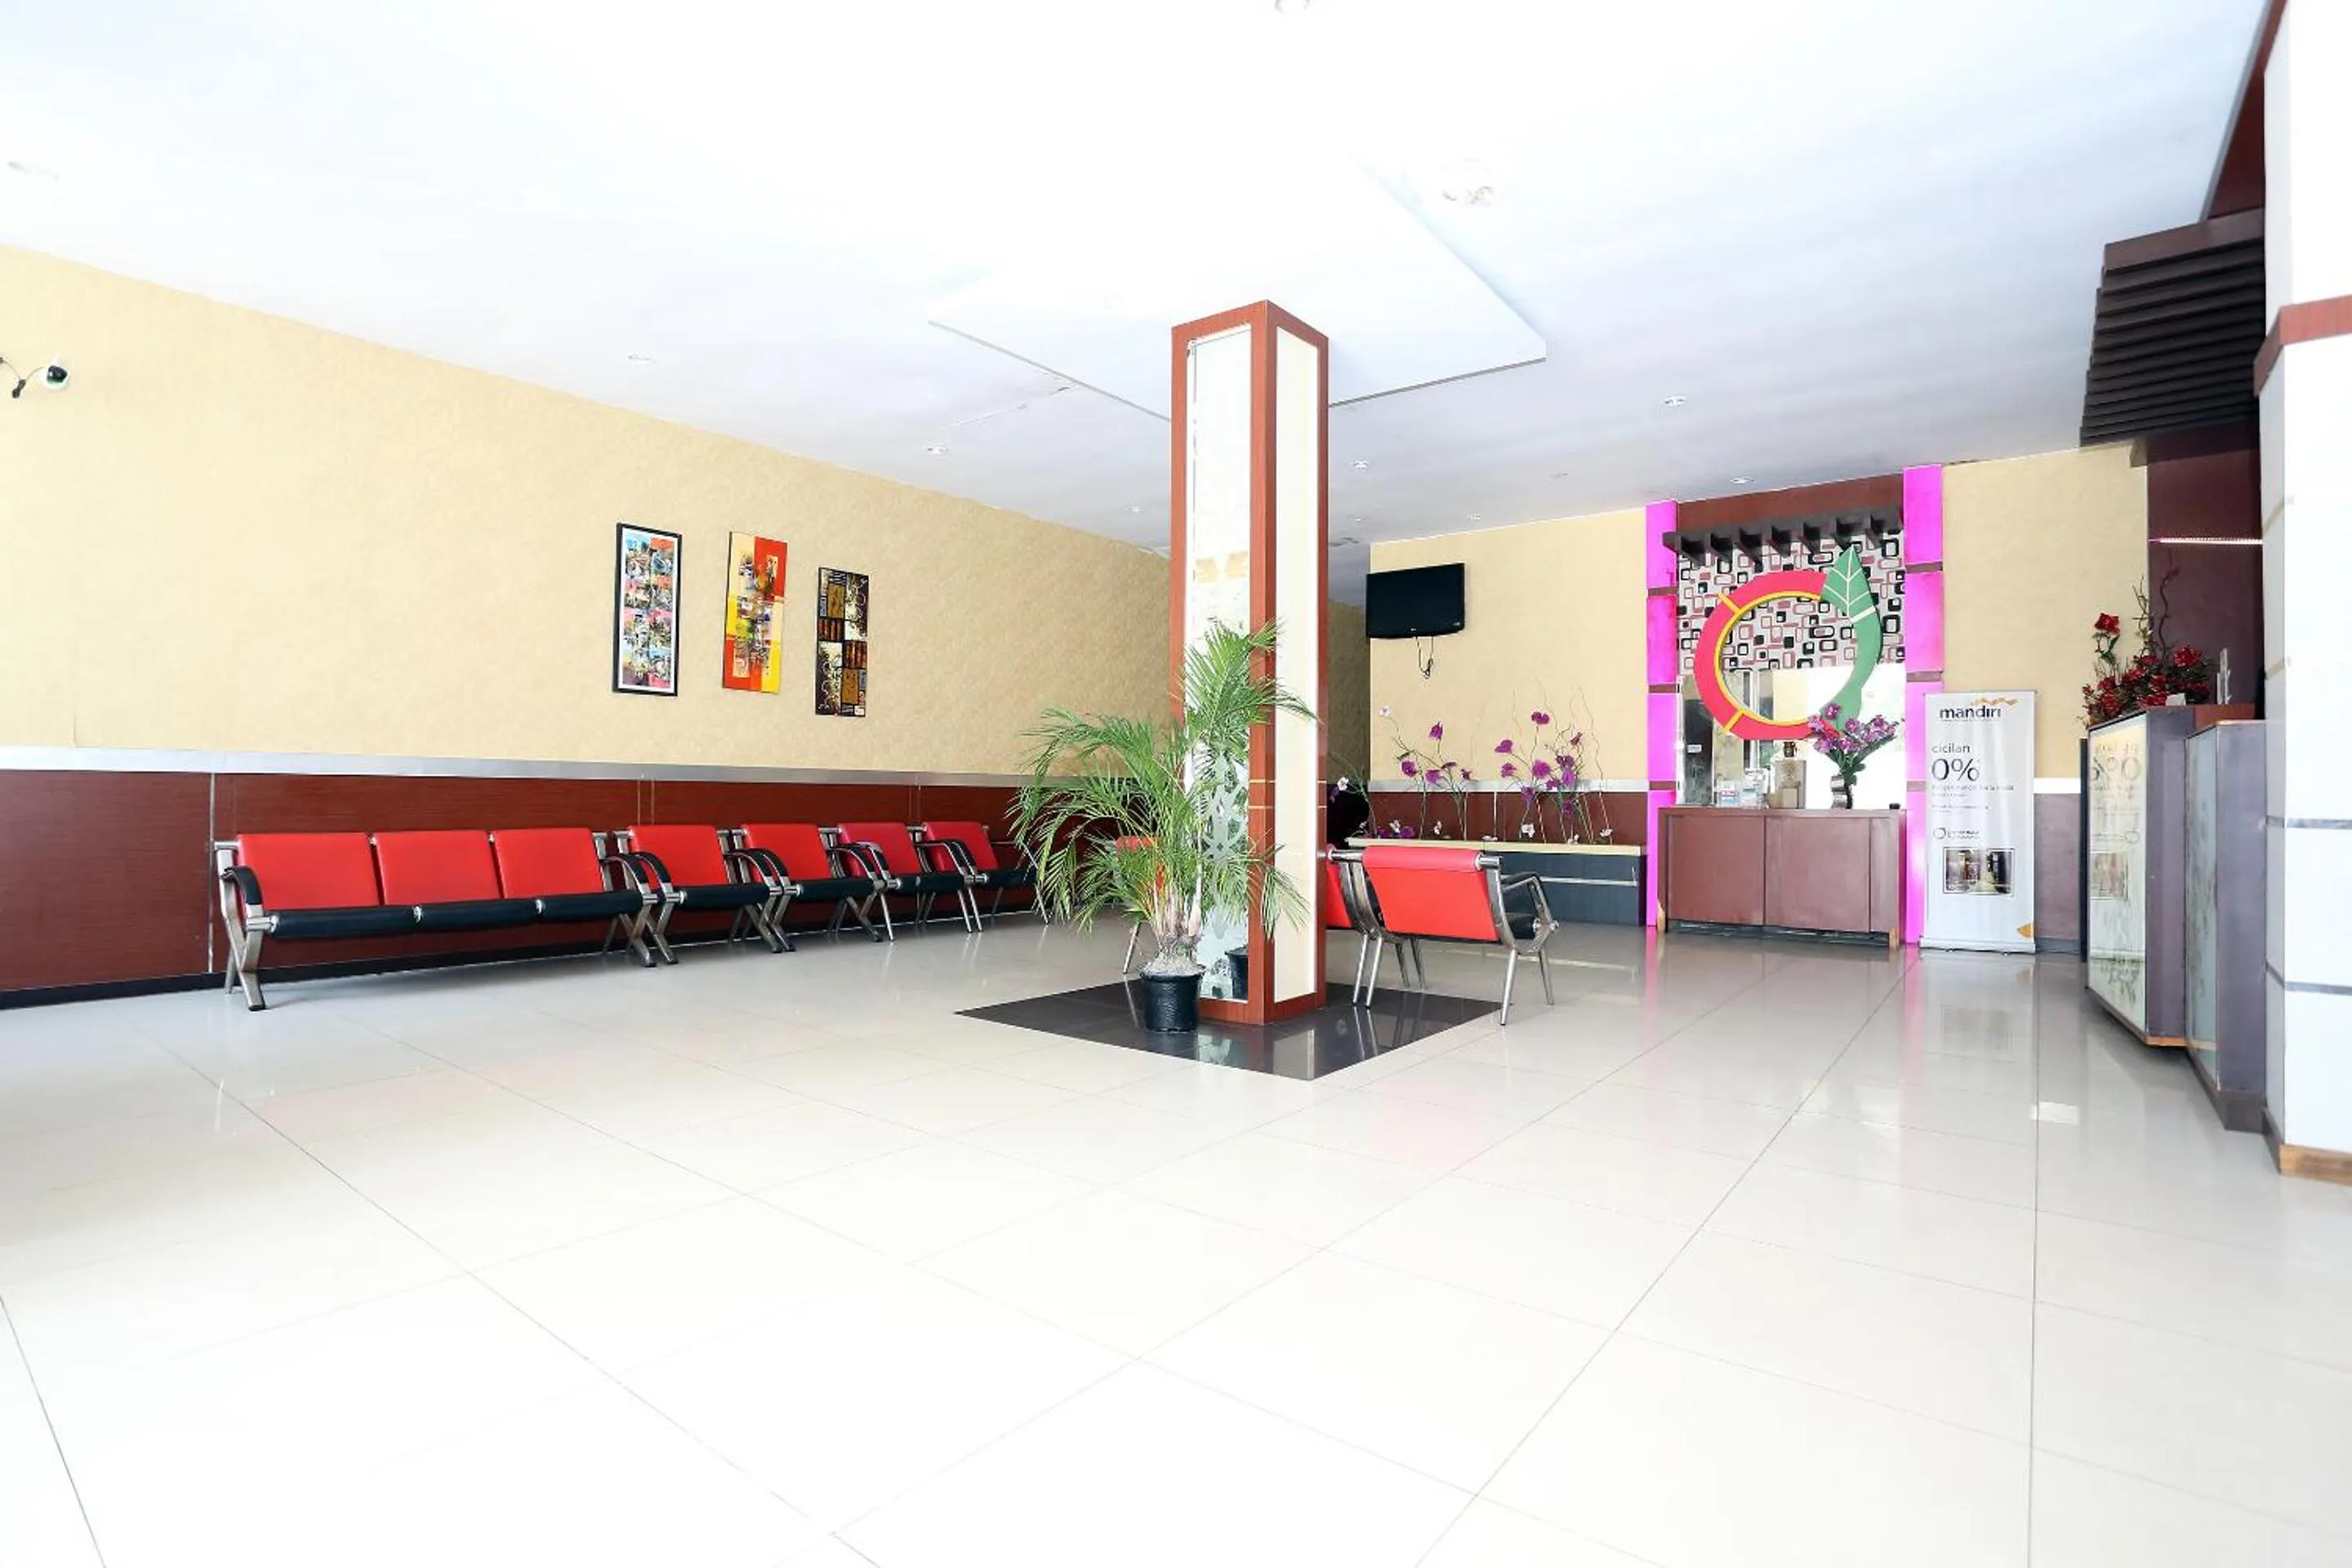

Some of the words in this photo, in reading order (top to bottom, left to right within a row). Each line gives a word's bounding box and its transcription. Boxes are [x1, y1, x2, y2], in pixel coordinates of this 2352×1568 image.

[1940, 706, 2002, 719] mandiri
[1931, 743, 1971, 753] cicilan
[1931, 758, 1980, 782] 0%
